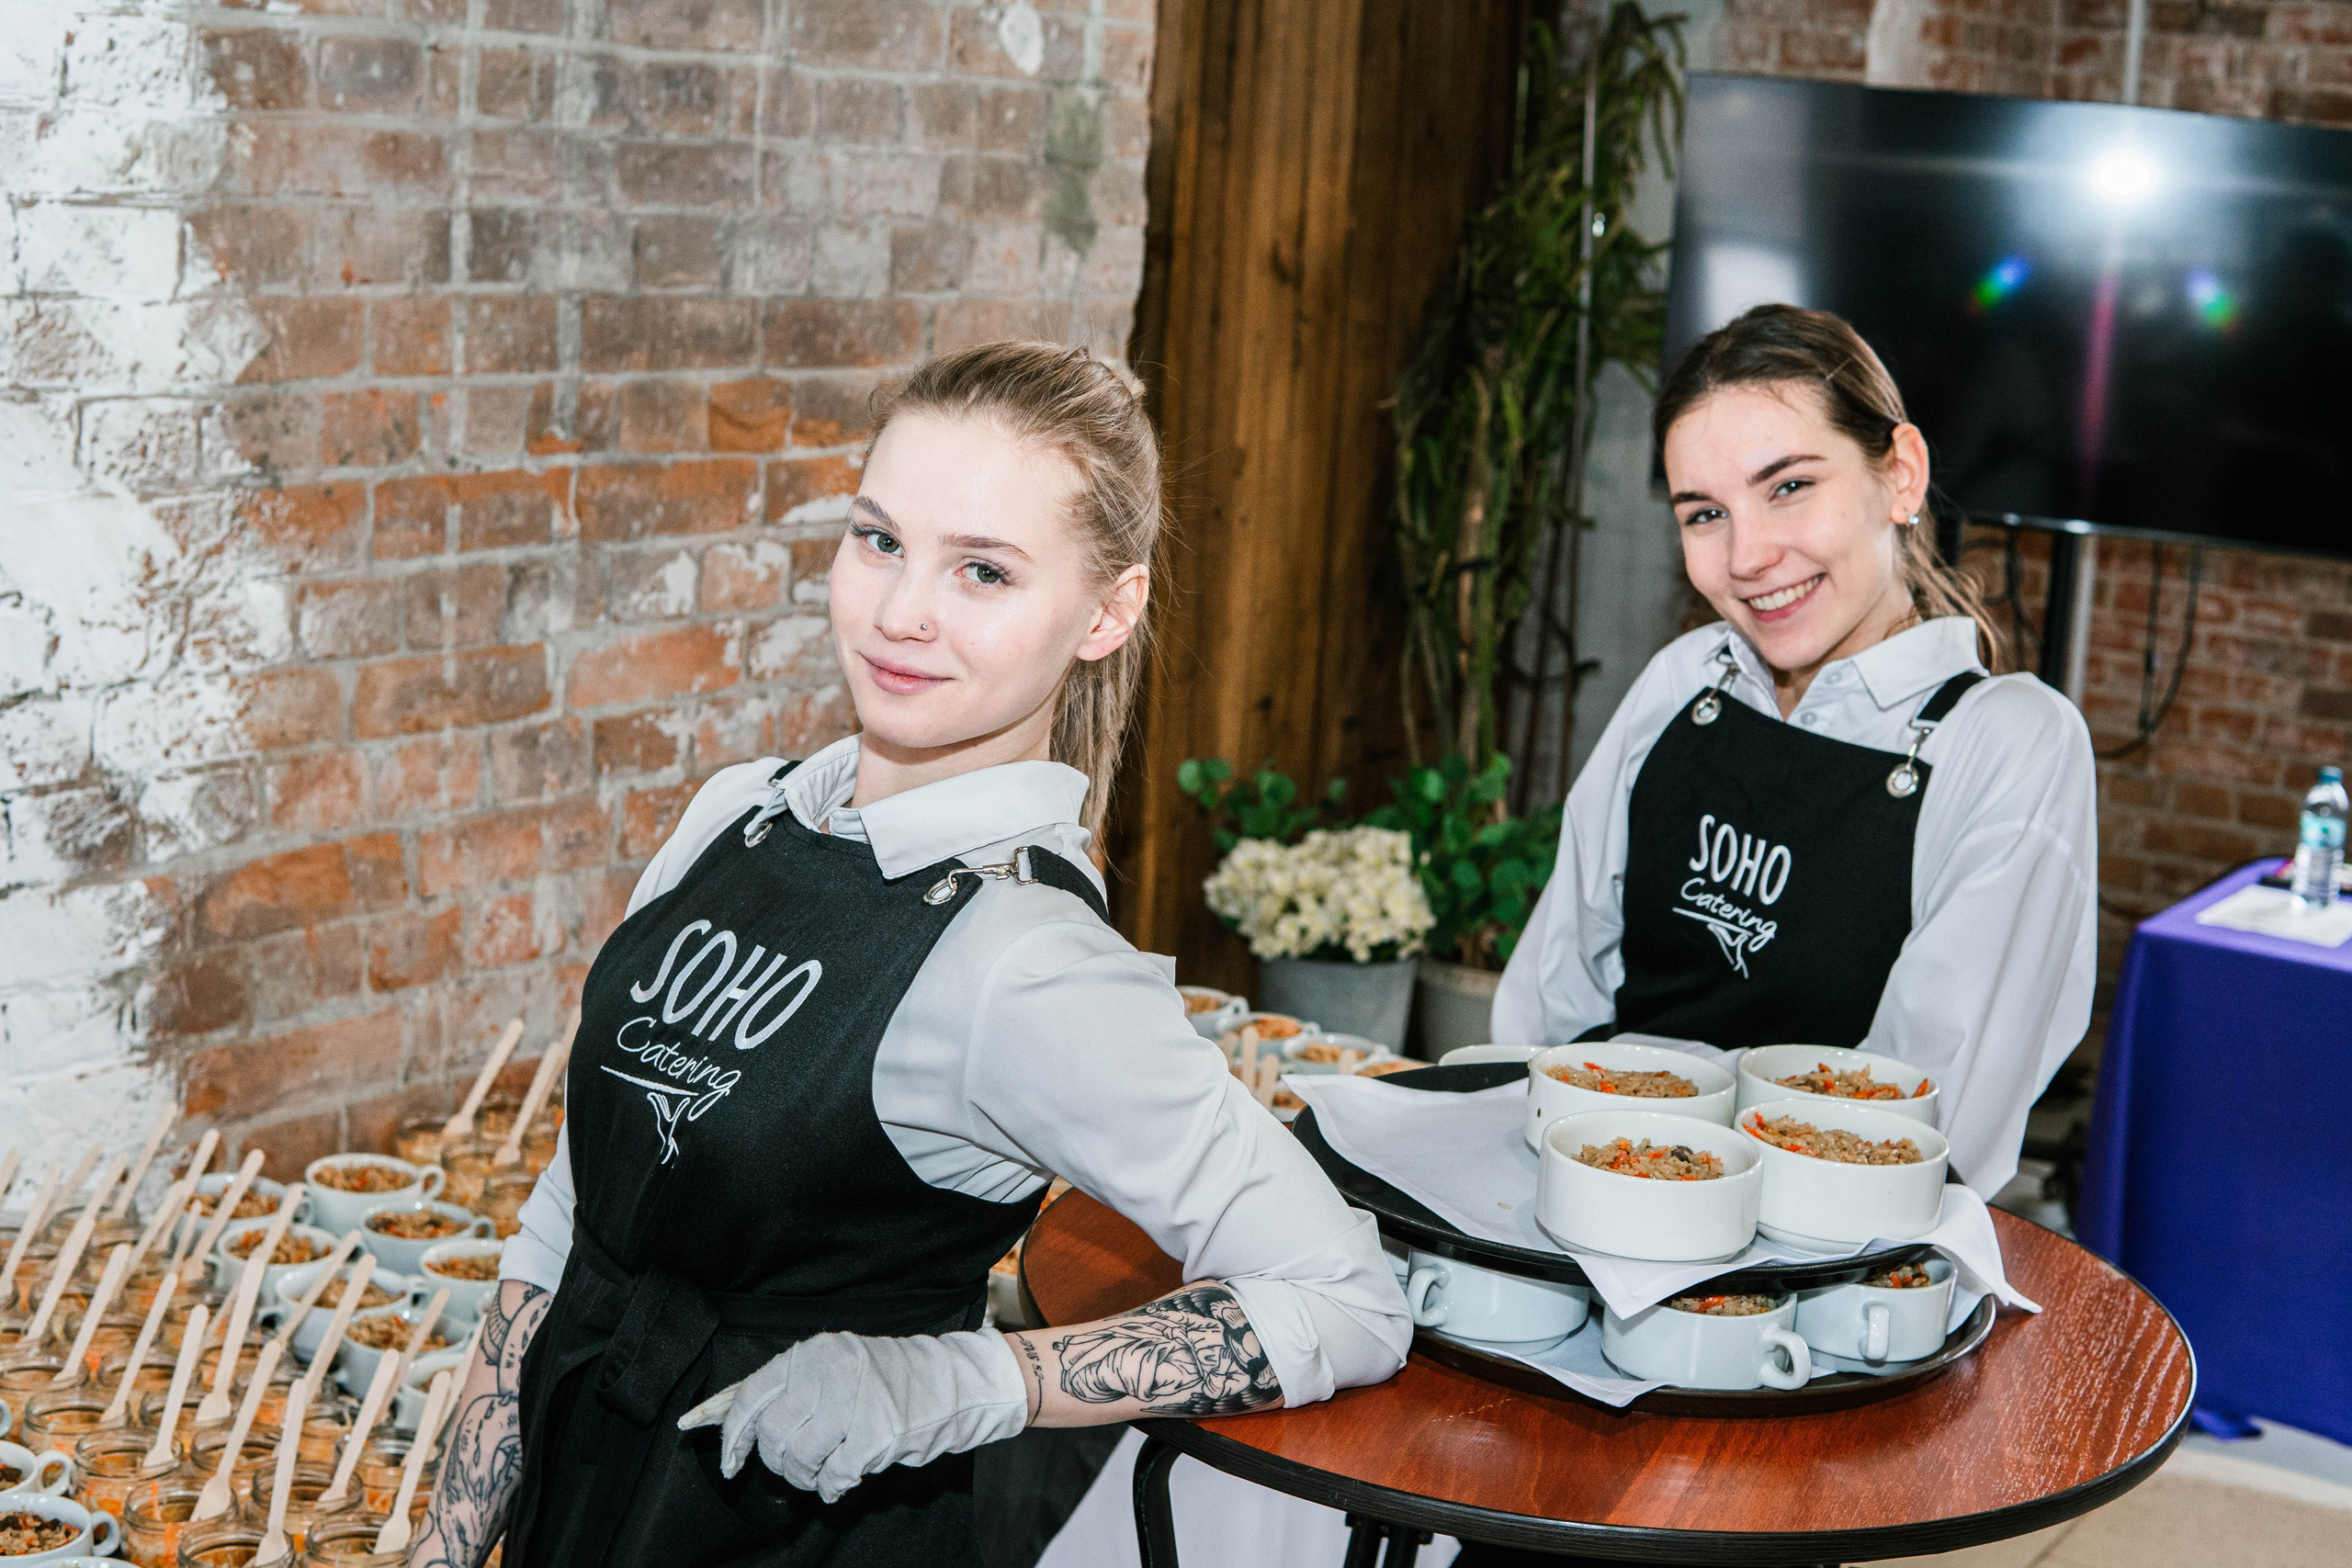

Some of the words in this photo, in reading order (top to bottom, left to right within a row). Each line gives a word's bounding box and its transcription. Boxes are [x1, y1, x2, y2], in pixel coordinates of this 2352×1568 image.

[1689, 814, 1791, 905] SOHO
[1680, 877, 1777, 953] Catering
[630, 919, 822, 1050] SOHO
[617, 1016, 741, 1122] Catering
